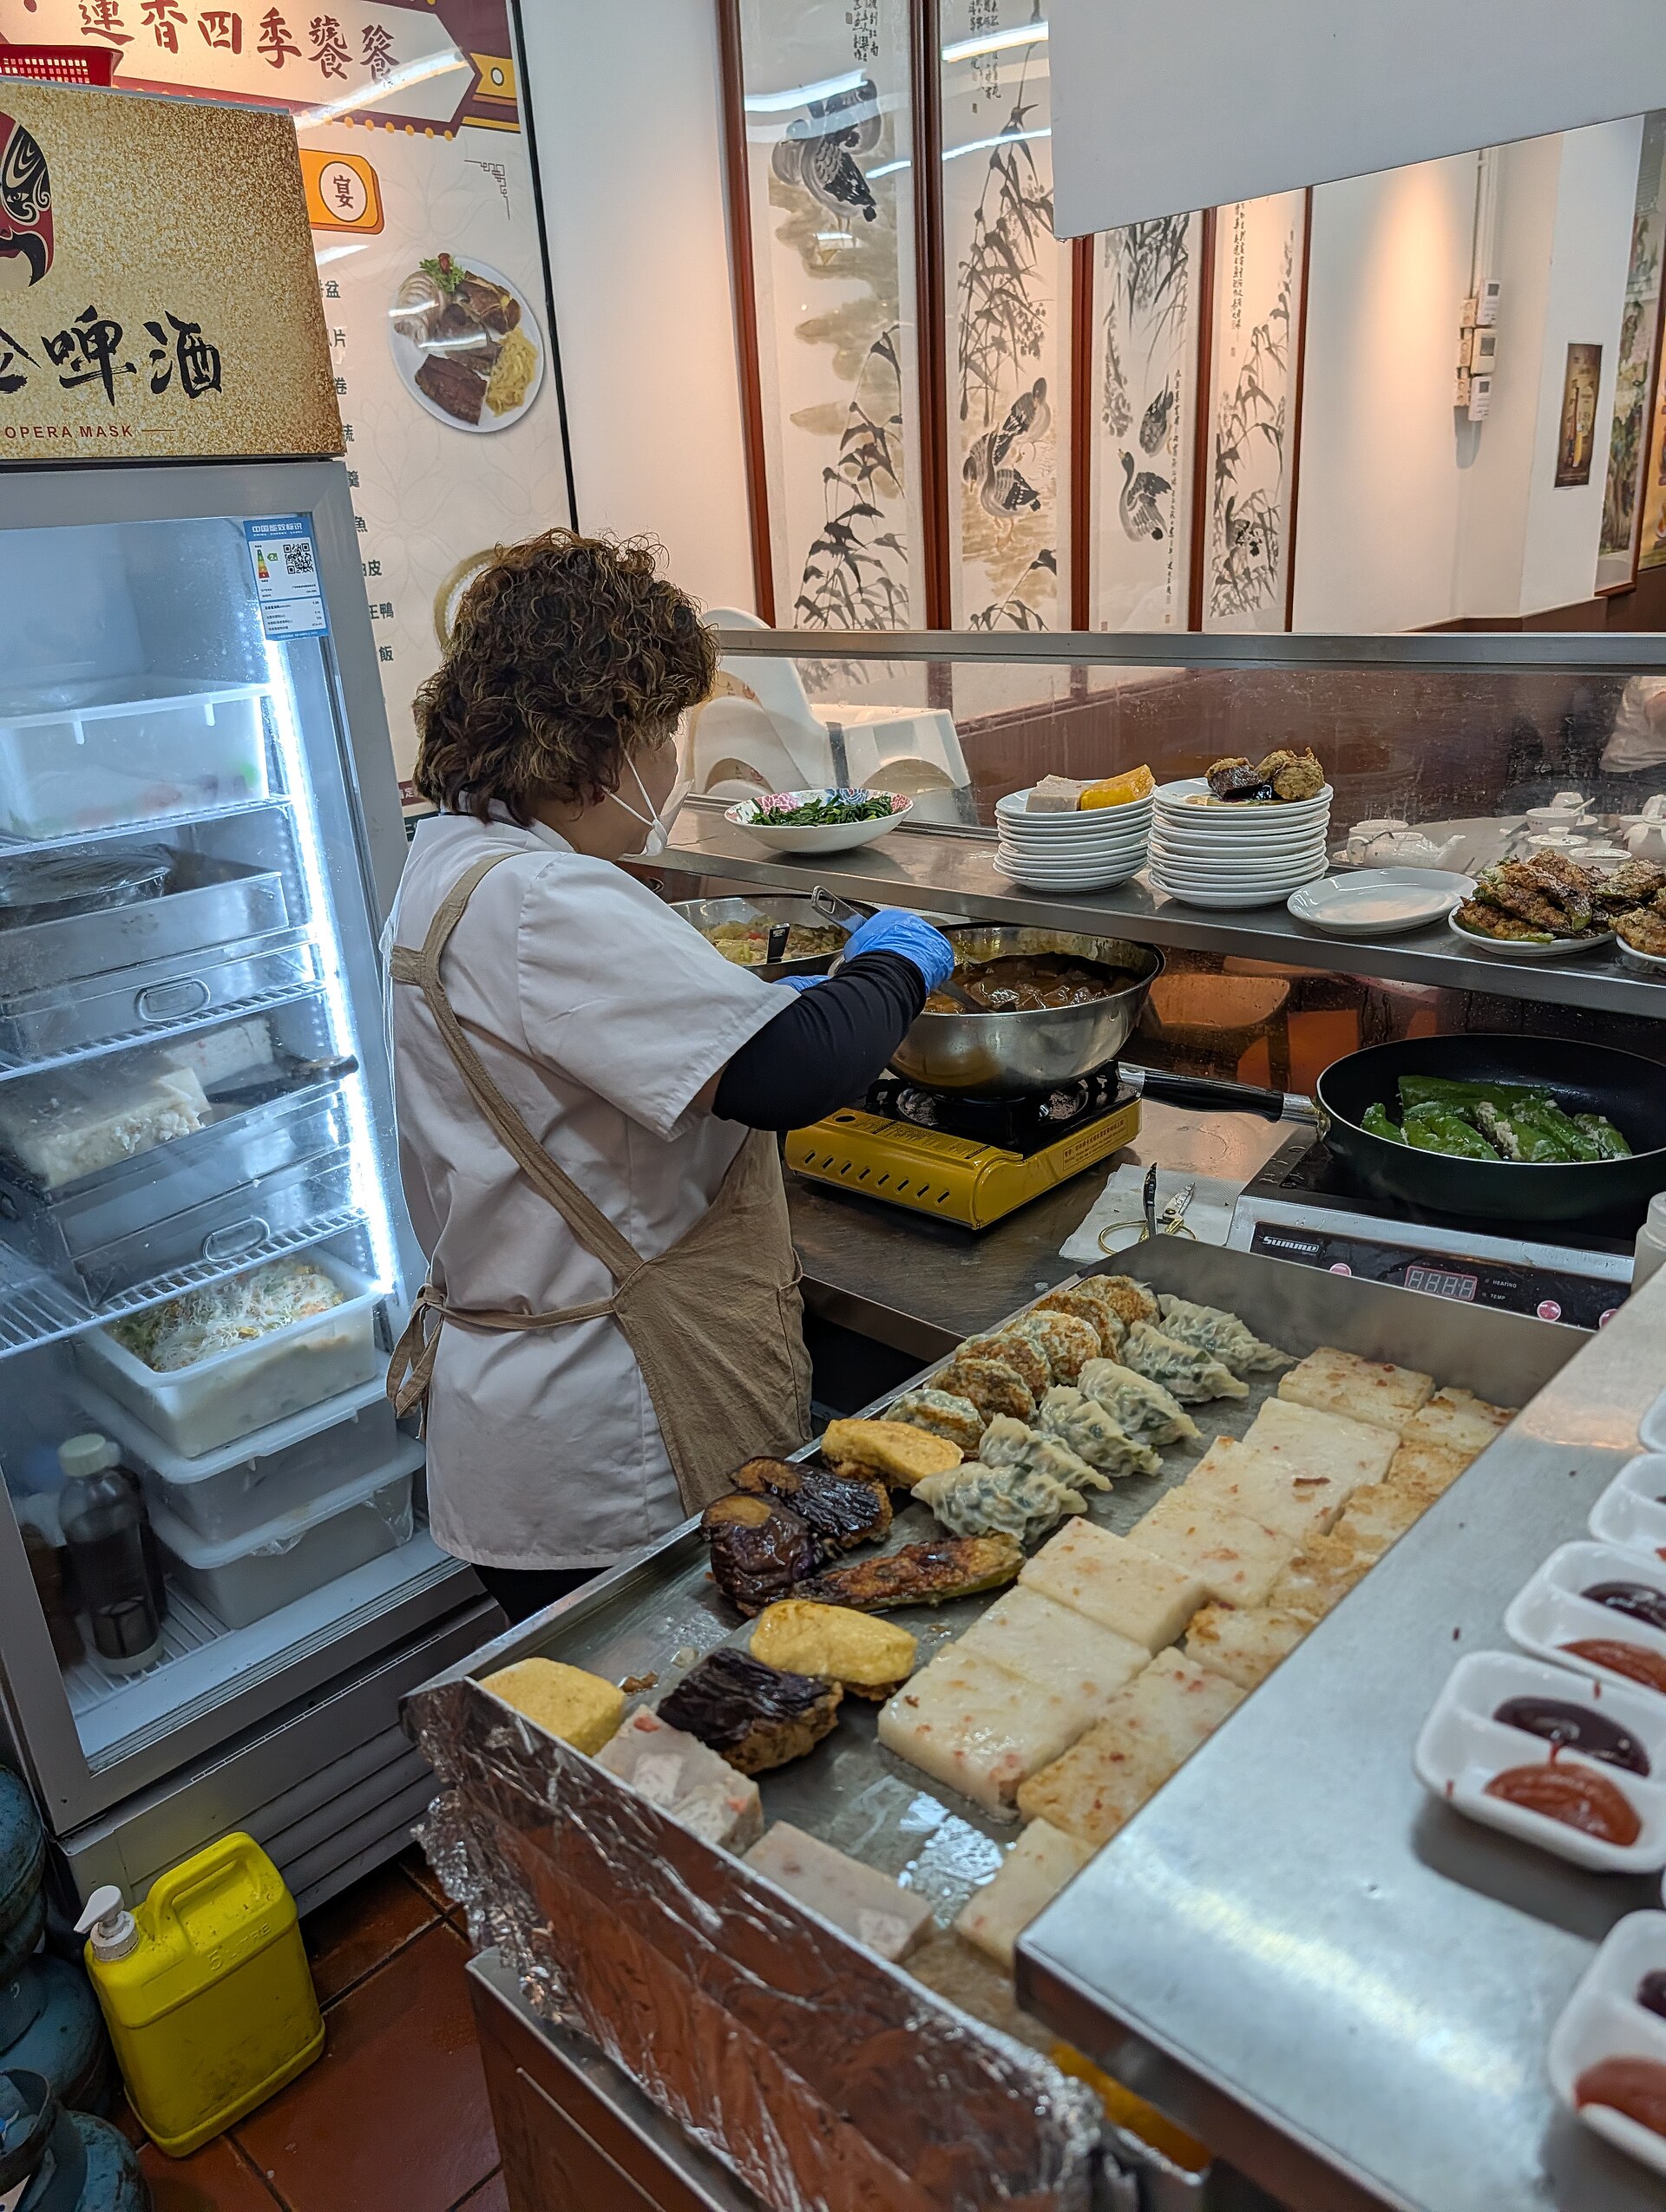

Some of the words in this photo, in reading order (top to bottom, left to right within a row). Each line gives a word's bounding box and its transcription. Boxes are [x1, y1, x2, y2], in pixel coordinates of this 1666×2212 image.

[333, 174, 353, 209] 宴
[4, 426, 73, 439] OPERA
[79, 425, 134, 438] MASK
[379, 646, 393, 662] 飯
[1492, 1279, 1517, 1288] HEATING
